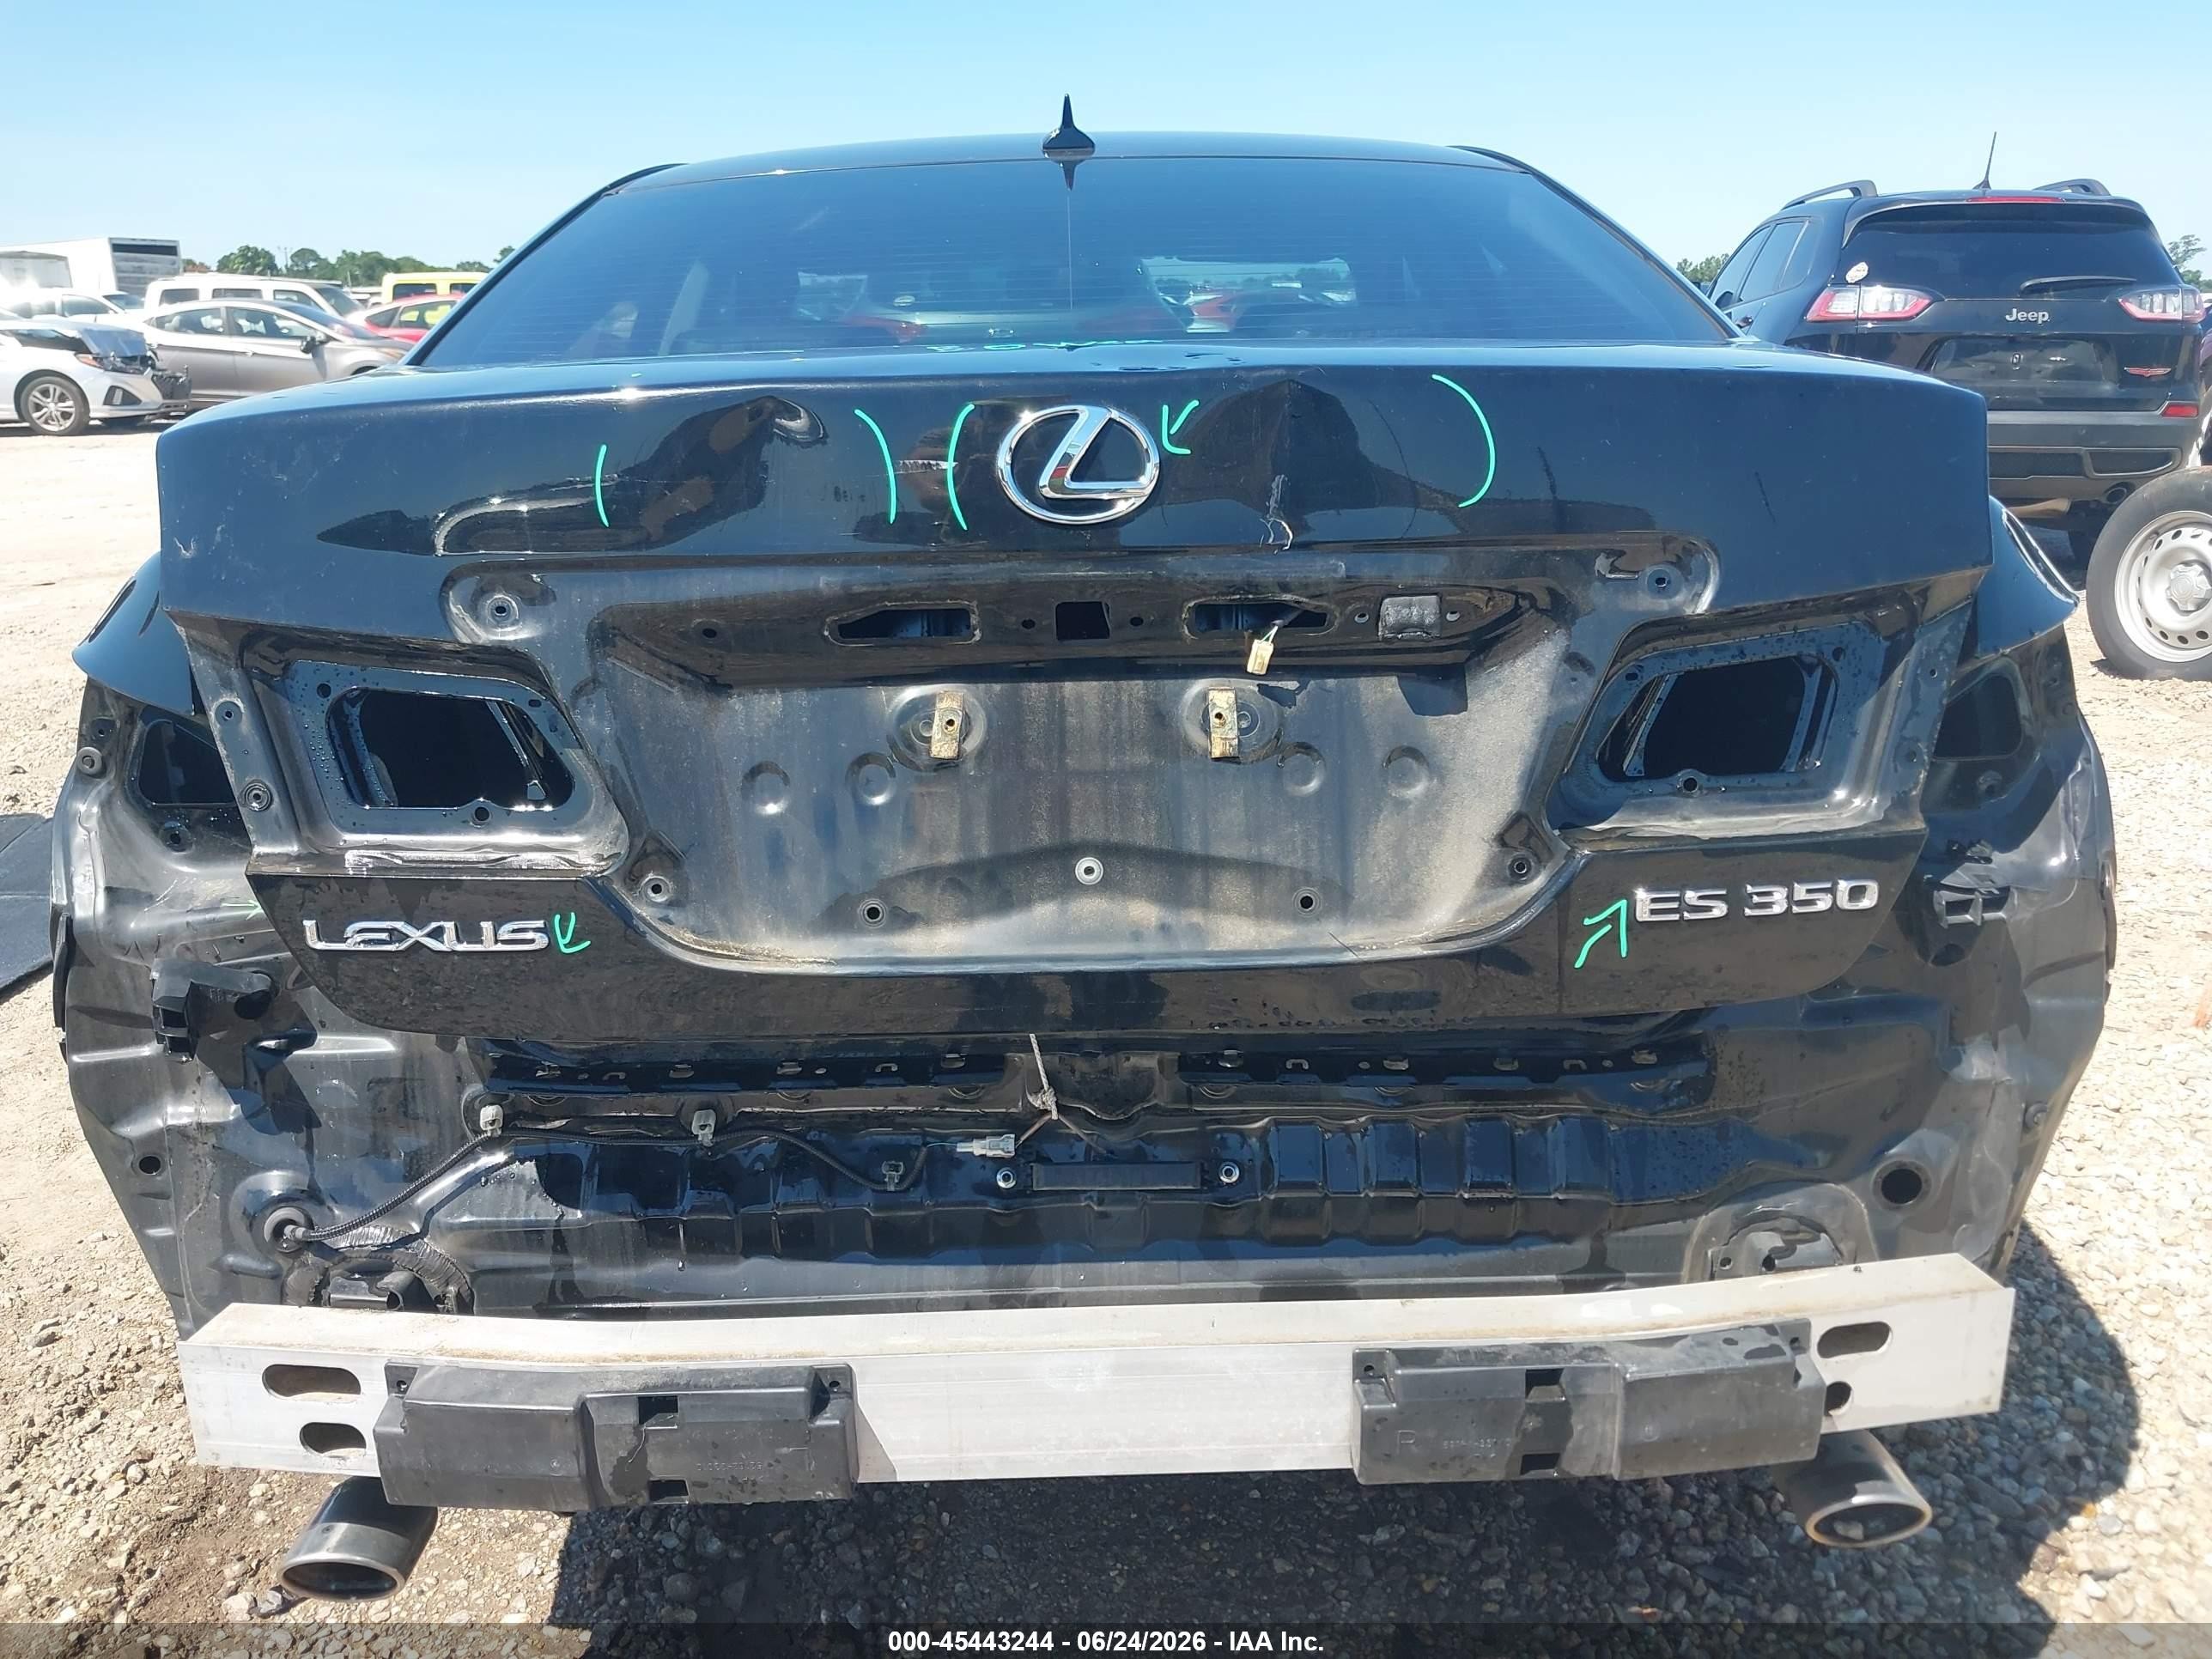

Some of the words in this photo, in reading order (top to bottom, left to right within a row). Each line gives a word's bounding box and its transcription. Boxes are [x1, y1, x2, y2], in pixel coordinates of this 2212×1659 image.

[1635, 887, 1729, 922] ES
[1744, 878, 1880, 917] 350
[302, 919, 550, 951] LEXUS
